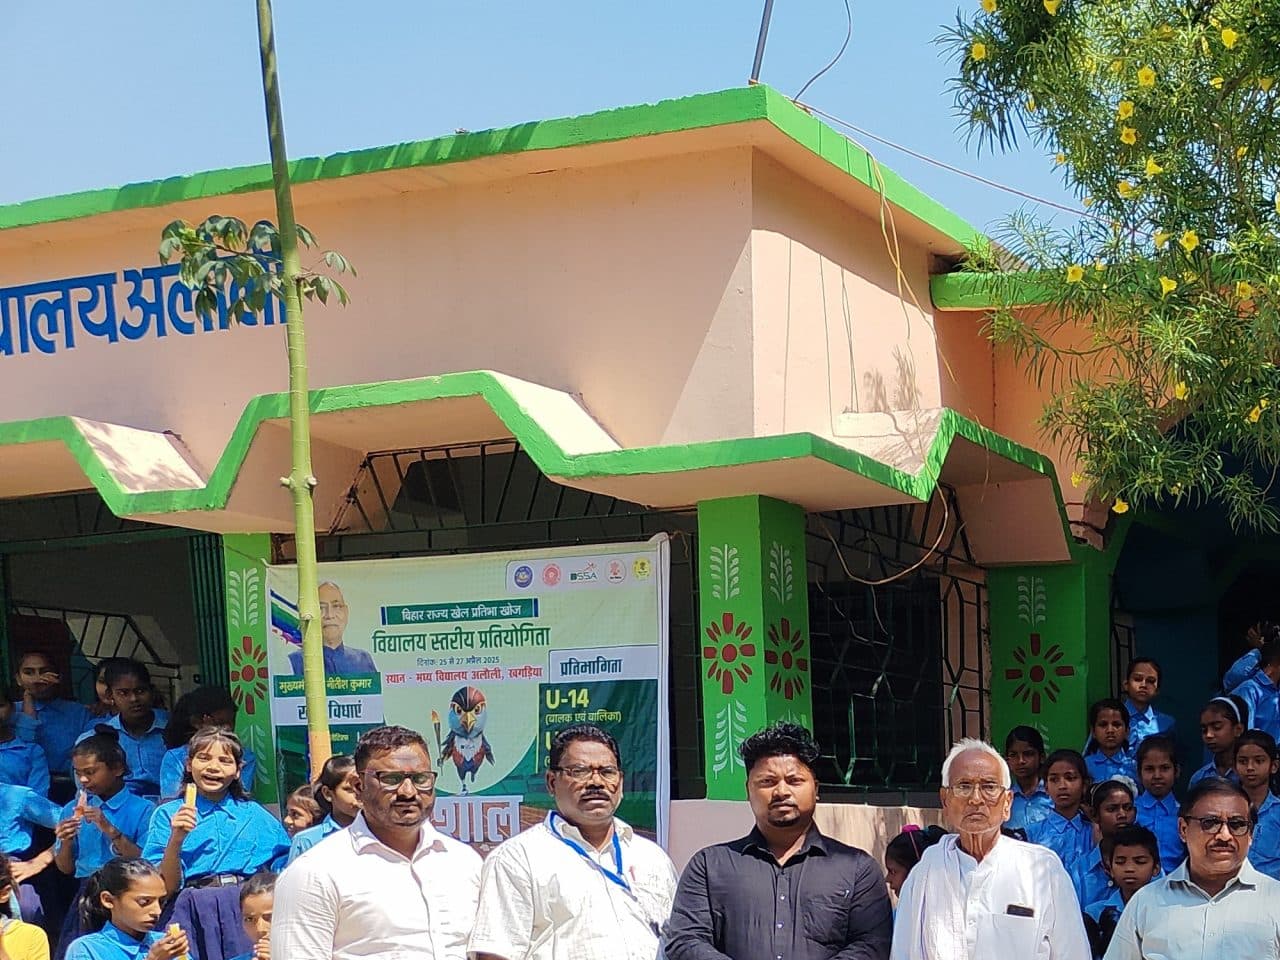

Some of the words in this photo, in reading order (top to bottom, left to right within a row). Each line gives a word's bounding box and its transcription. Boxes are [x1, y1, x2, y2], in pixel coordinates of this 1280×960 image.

[401, 607, 424, 621] बिहार
[426, 607, 448, 620] राज्य
[451, 604, 469, 619] खेल
[471, 603, 497, 618] प्रतिभा
[500, 602, 522, 616] खोज
[372, 630, 427, 653] विद्यालय
[430, 626, 475, 651] स्तरीय
[478, 622, 551, 649] प्रतियोगिता
[439, 658, 447, 666] 25
[456, 657, 464, 665] 27
[483, 656, 500, 664] 2025
[560, 656, 623, 676] प्रतिभागिता
[546, 688, 589, 710] U-14
